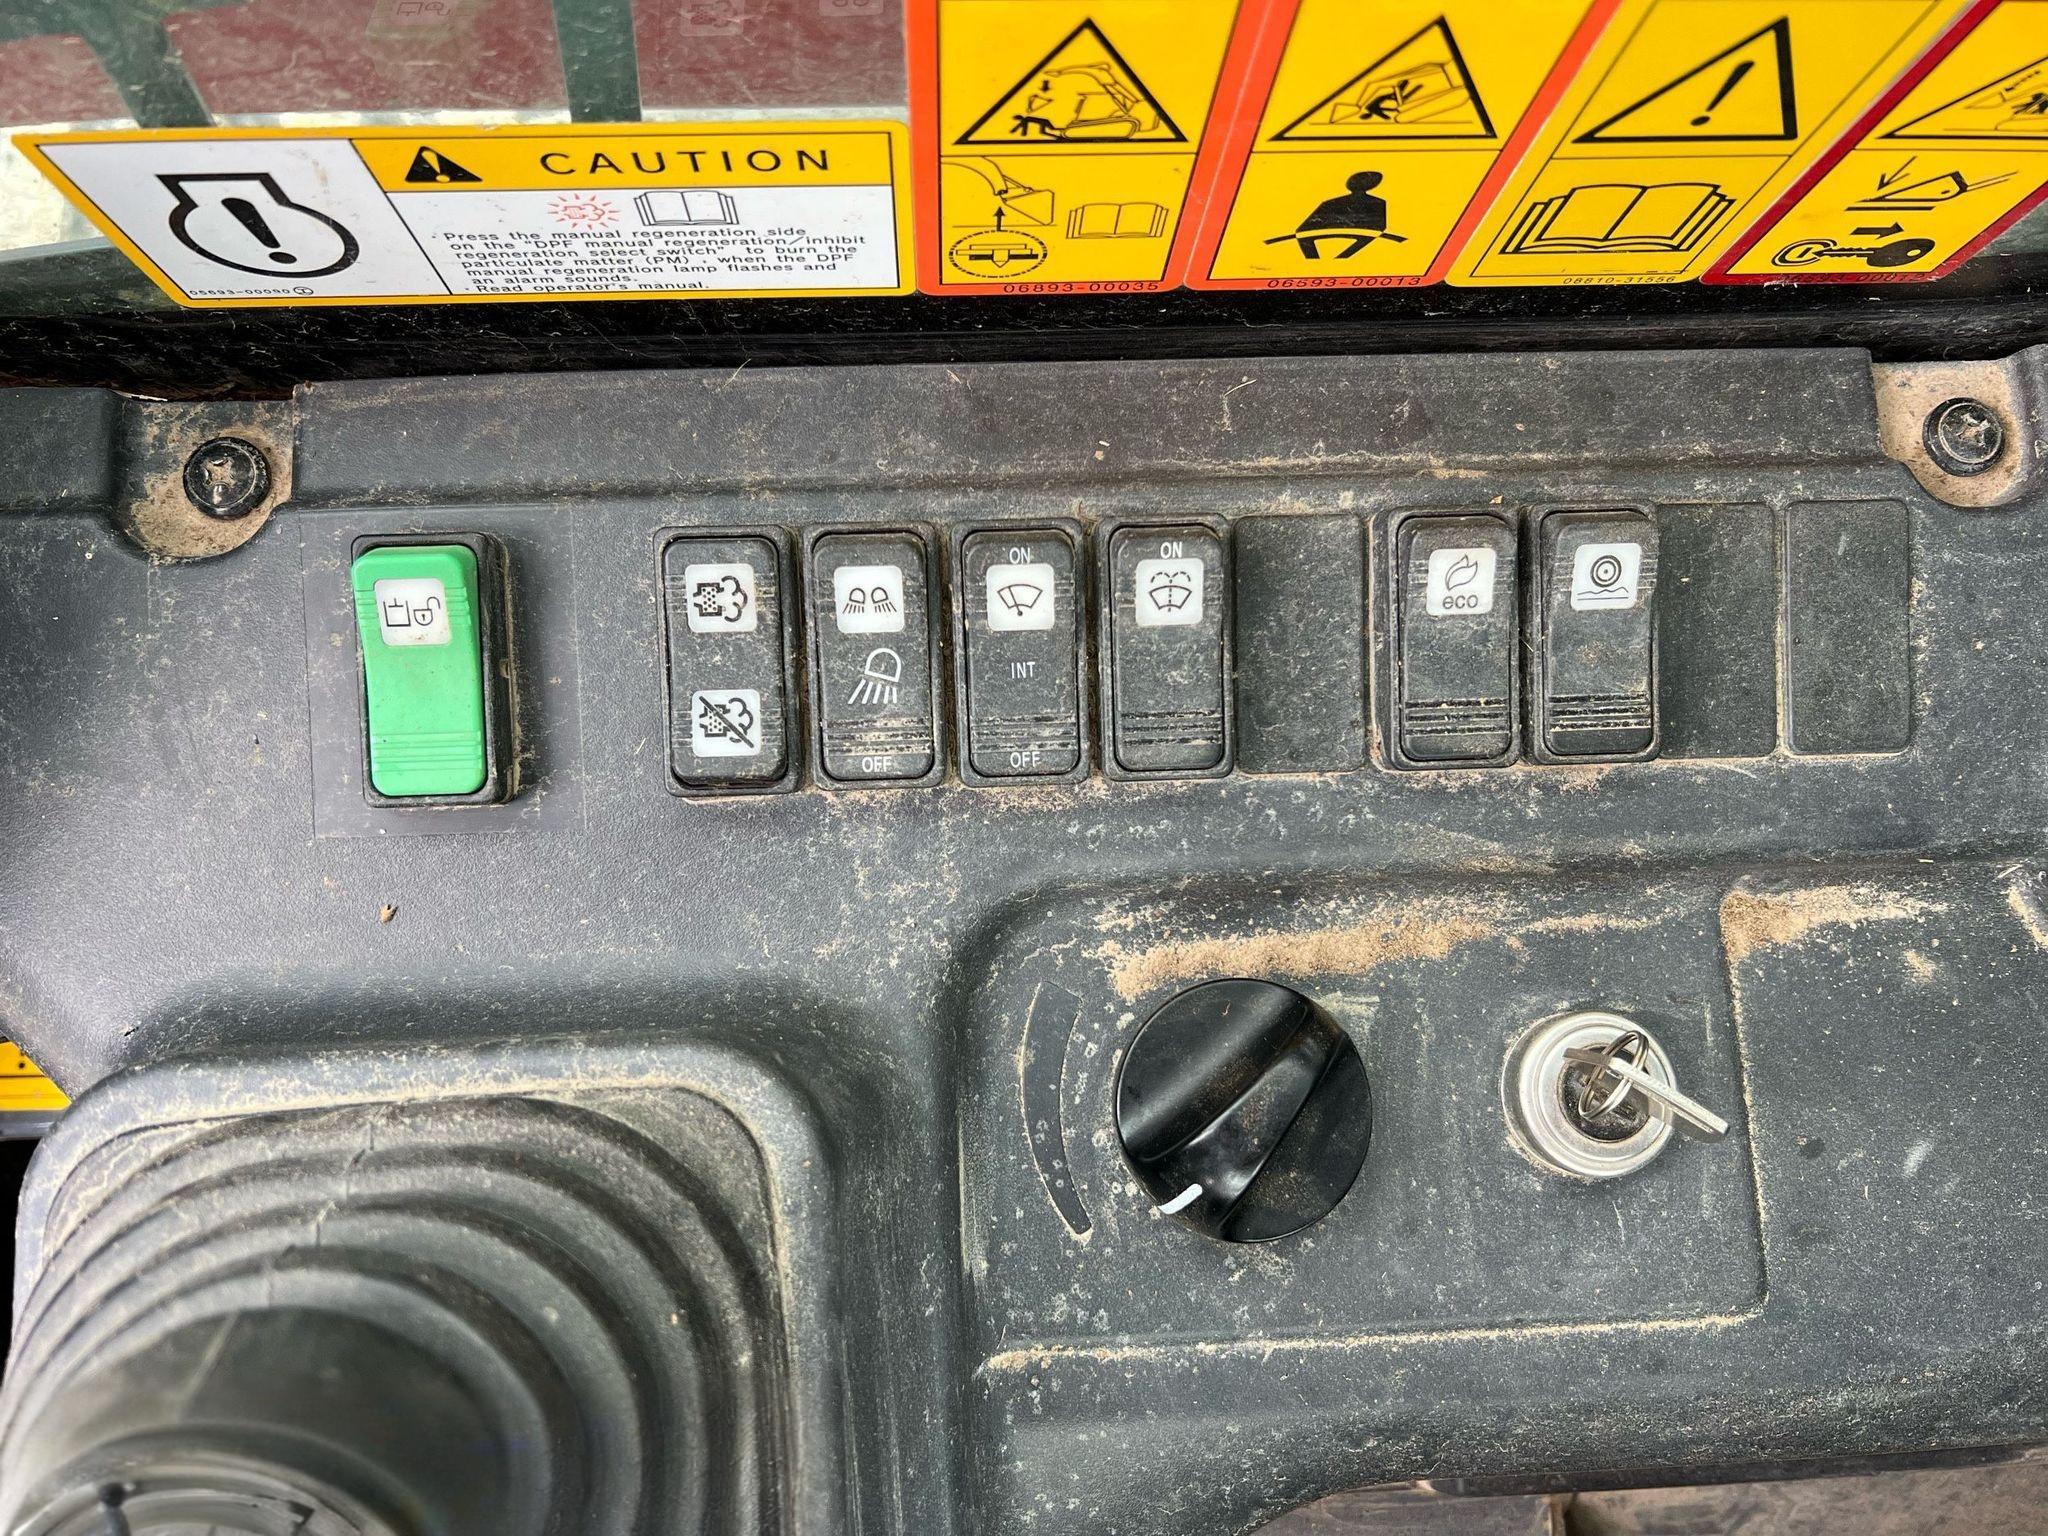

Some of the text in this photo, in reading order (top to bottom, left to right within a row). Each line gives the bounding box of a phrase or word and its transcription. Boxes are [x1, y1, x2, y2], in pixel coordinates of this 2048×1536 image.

[539, 149, 829, 175] CAUTION
[444, 227, 806, 241] Press the manual regeneration side
[450, 242, 474, 250] on
[484, 241, 515, 249] the
[585, 239, 654, 247] manual
[664, 236, 867, 248] regeneration/inhibit
[456, 249, 579, 260] regeneration
[590, 248, 646, 257] select
[829, 245, 857, 253] the
[461, 258, 564, 269] particulate
[574, 257, 634, 266] matter
[645, 255, 689, 265] (PM)
[718, 255, 766, 263] when
[777, 254, 806, 262] the
[817, 254, 854, 262] DPF
[466, 267, 534, 276] manual
[544, 266, 664, 276] regeneration
[674, 264, 717, 273] lamp
[728, 263, 793, 271] flashes
[472, 274, 638, 285] an alarm sounds.
[476, 281, 710, 293] Read operator's manual.
[1003, 281, 1159, 293] 06893-00035
[1267, 277, 1421, 288] 06593-00013
[1563, 275, 1676, 285] 08810-31556
[1009, 547, 1031, 564] ON
[1160, 541, 1183, 559] ON
[1442, 593, 1479, 610] eco
[1011, 661, 1036, 679] INT
[861, 756, 893, 773] OFF
[1009, 751, 1042, 769] OFF
